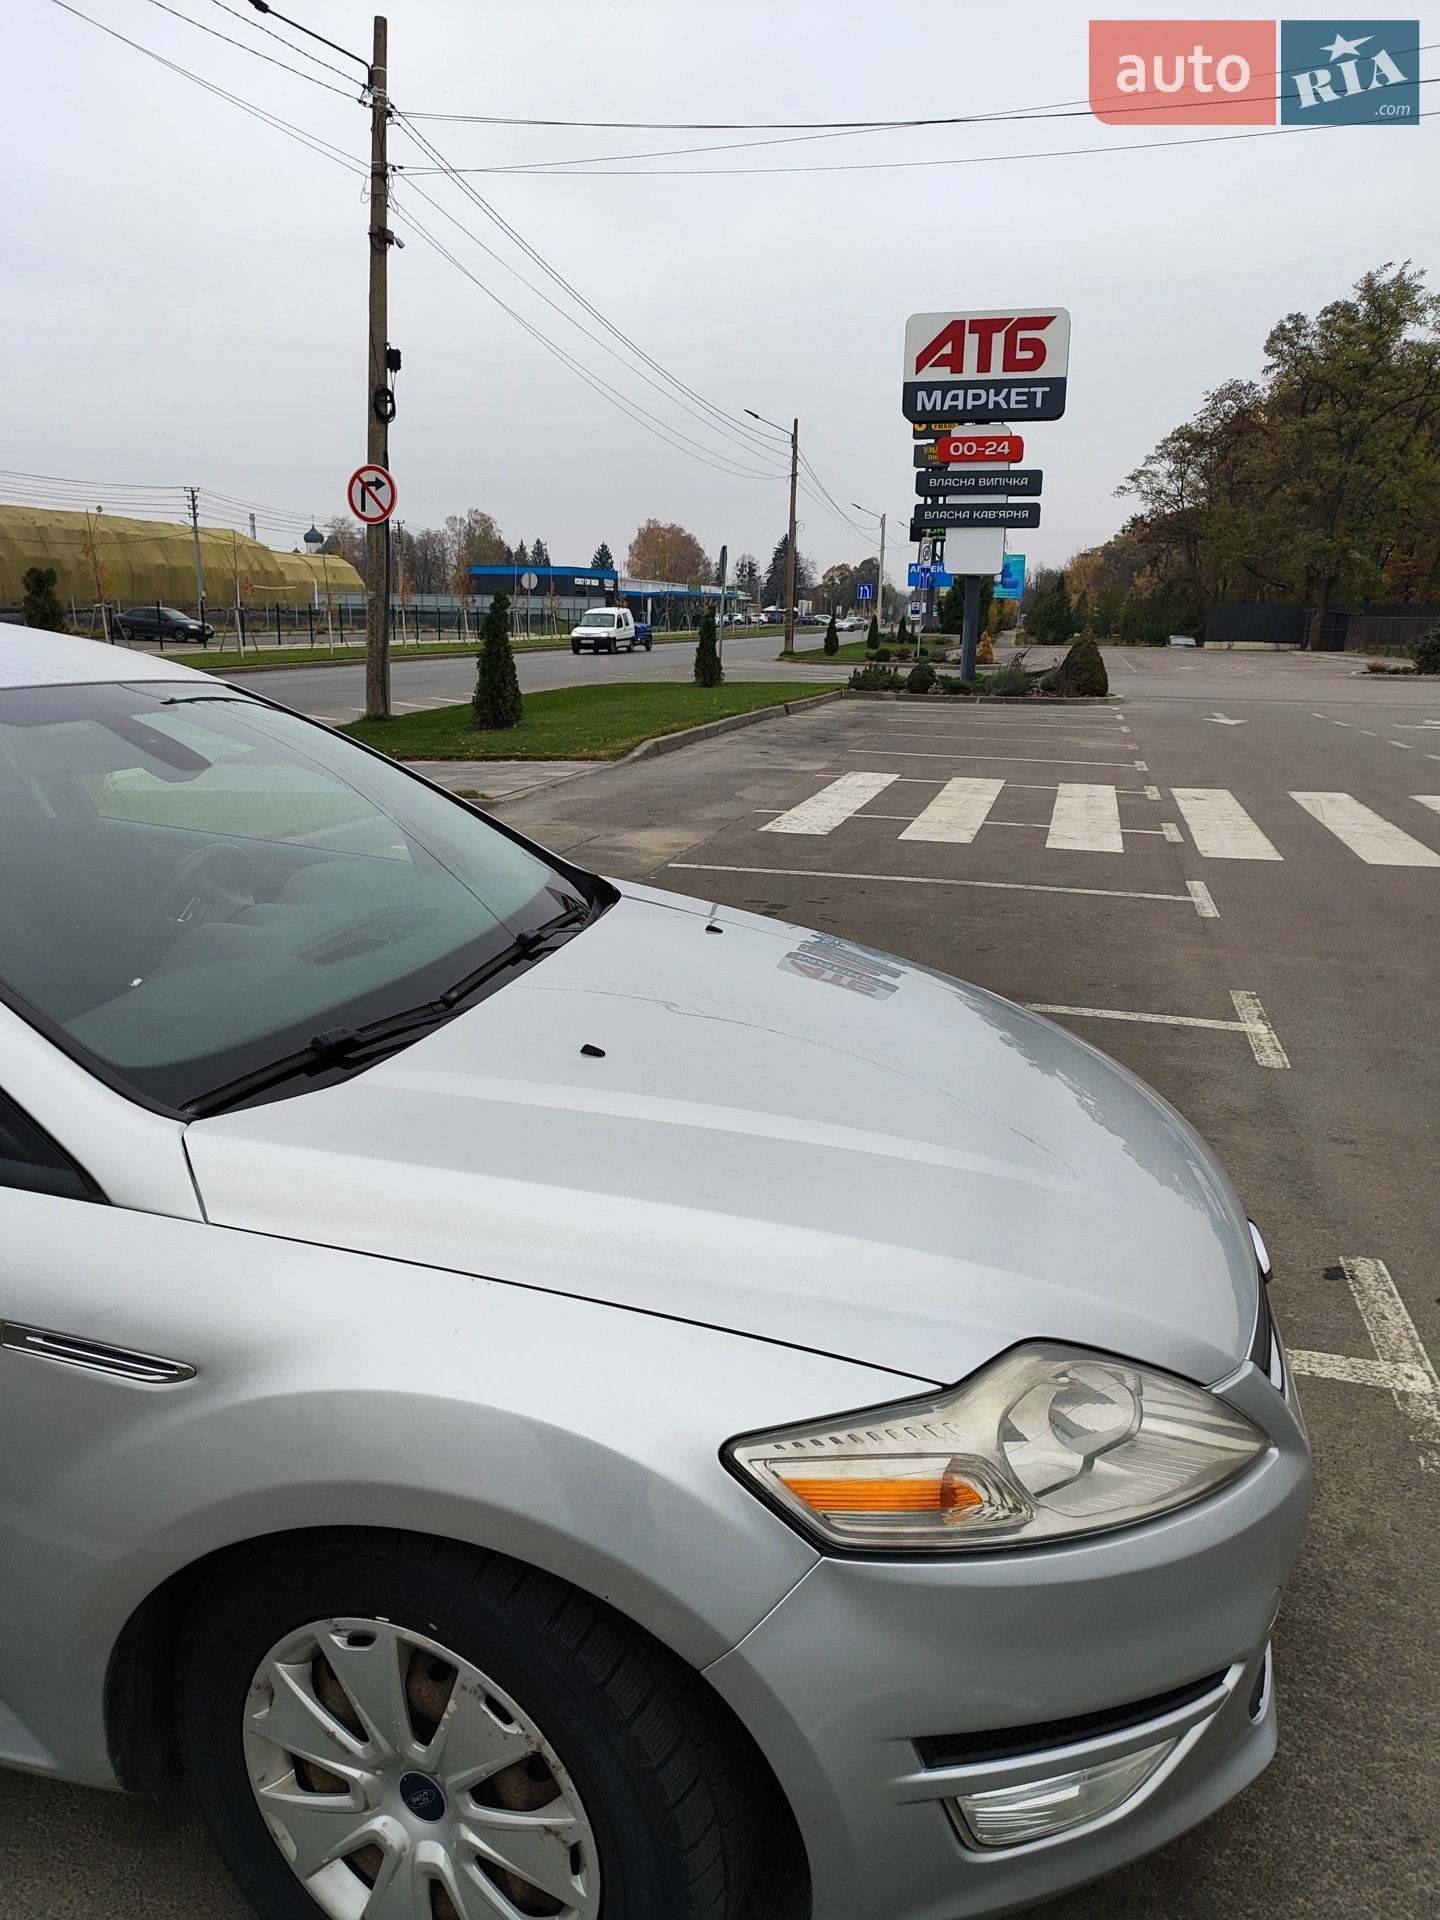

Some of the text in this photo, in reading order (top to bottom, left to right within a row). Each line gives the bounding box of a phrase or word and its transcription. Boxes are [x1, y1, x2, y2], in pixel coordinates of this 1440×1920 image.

[915, 315, 1058, 377] АТБ
[916, 386, 1050, 412] МАРКЕТ
[949, 440, 1011, 456] 00-24
[929, 477, 1029, 487] ВЛАСНА ВИПІЧКА
[924, 510, 1030, 520] ВЛАСНА КАВ'ЯРНЯ
